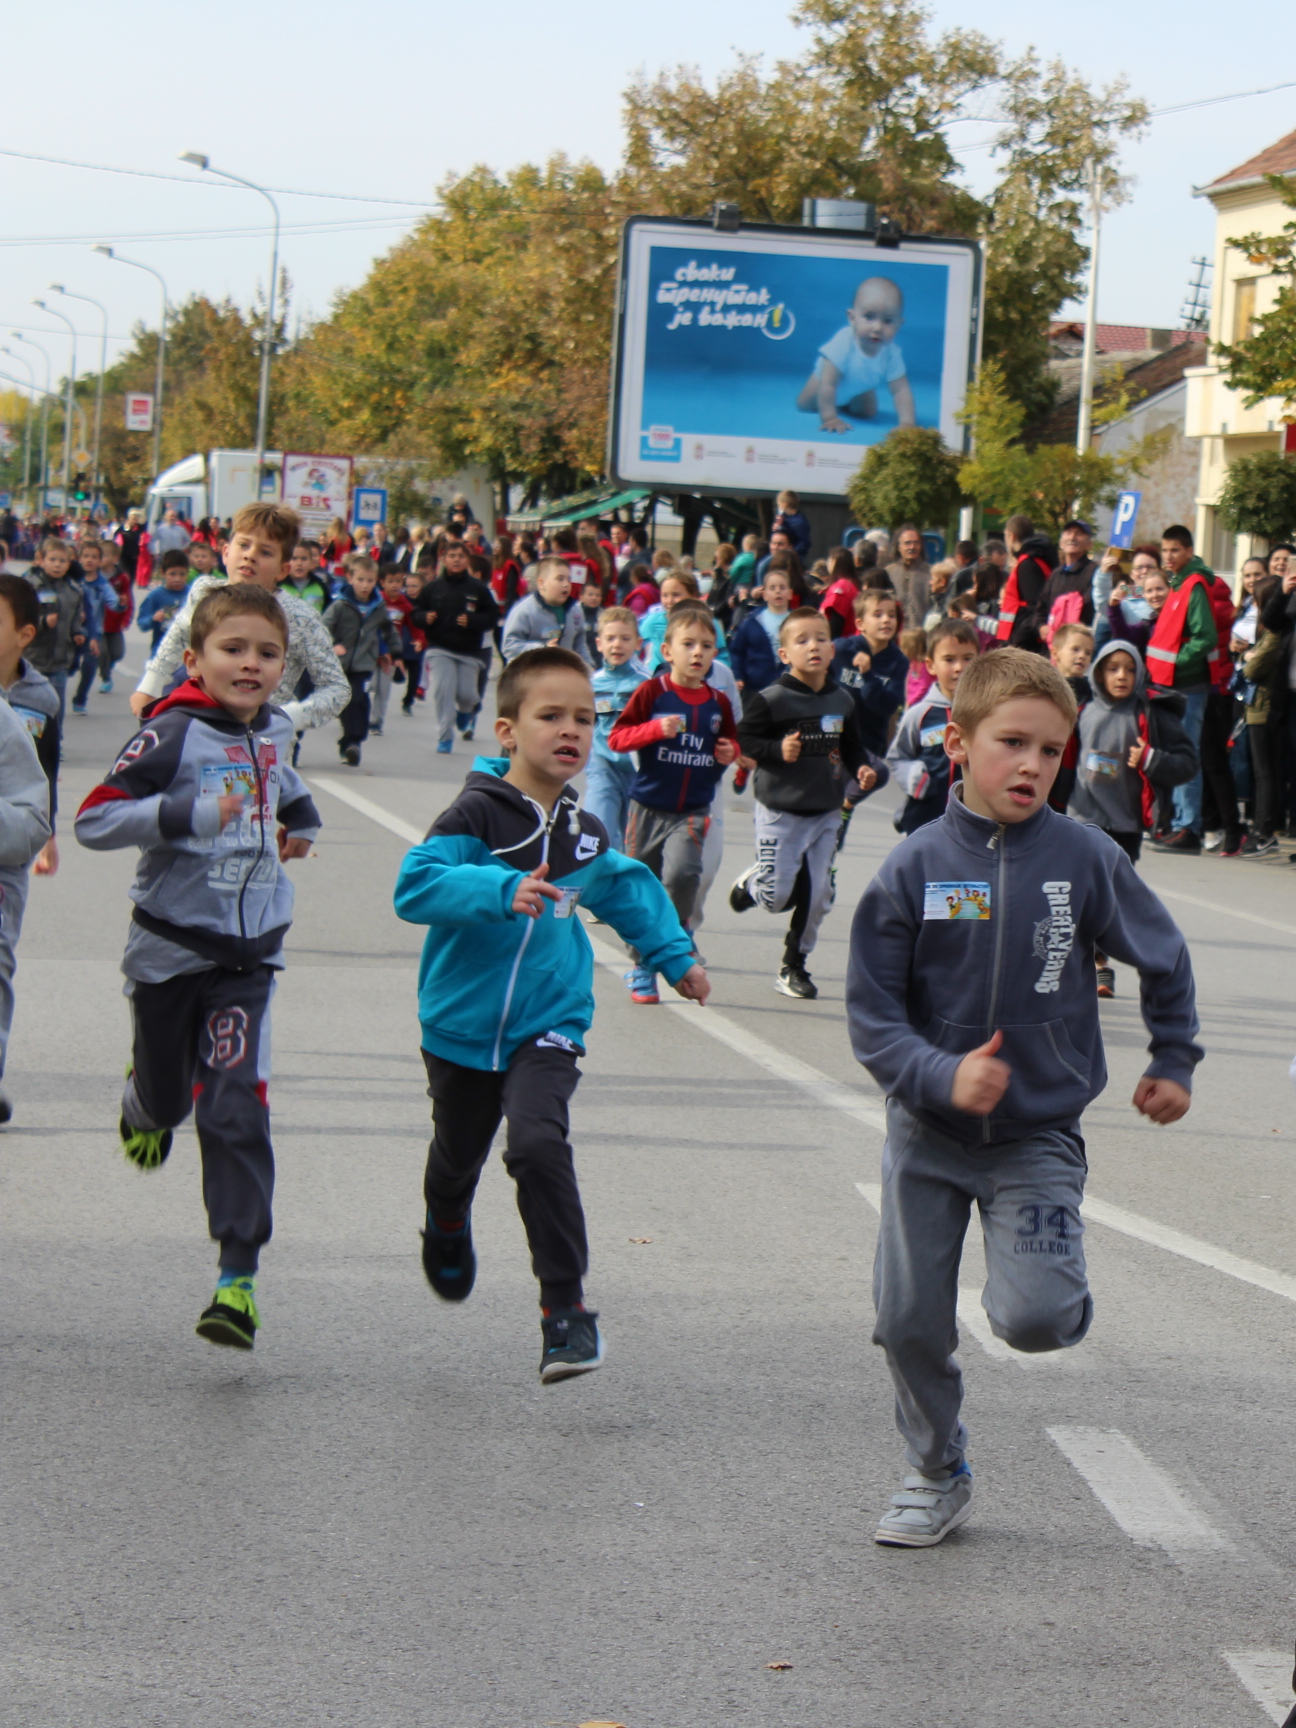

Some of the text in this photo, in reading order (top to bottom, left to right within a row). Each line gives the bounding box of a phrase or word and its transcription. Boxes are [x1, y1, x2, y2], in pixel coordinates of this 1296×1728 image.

[674, 259, 736, 282] сваки
[1114, 495, 1136, 535] P
[681, 733, 704, 751] Fly
[580, 833, 600, 852] NIKE
[759, 838, 777, 874] SIDE
[546, 1030, 574, 1049] NIKE
[1015, 1204, 1069, 1240] 34
[1013, 1240, 1071, 1256] COLLEGE
